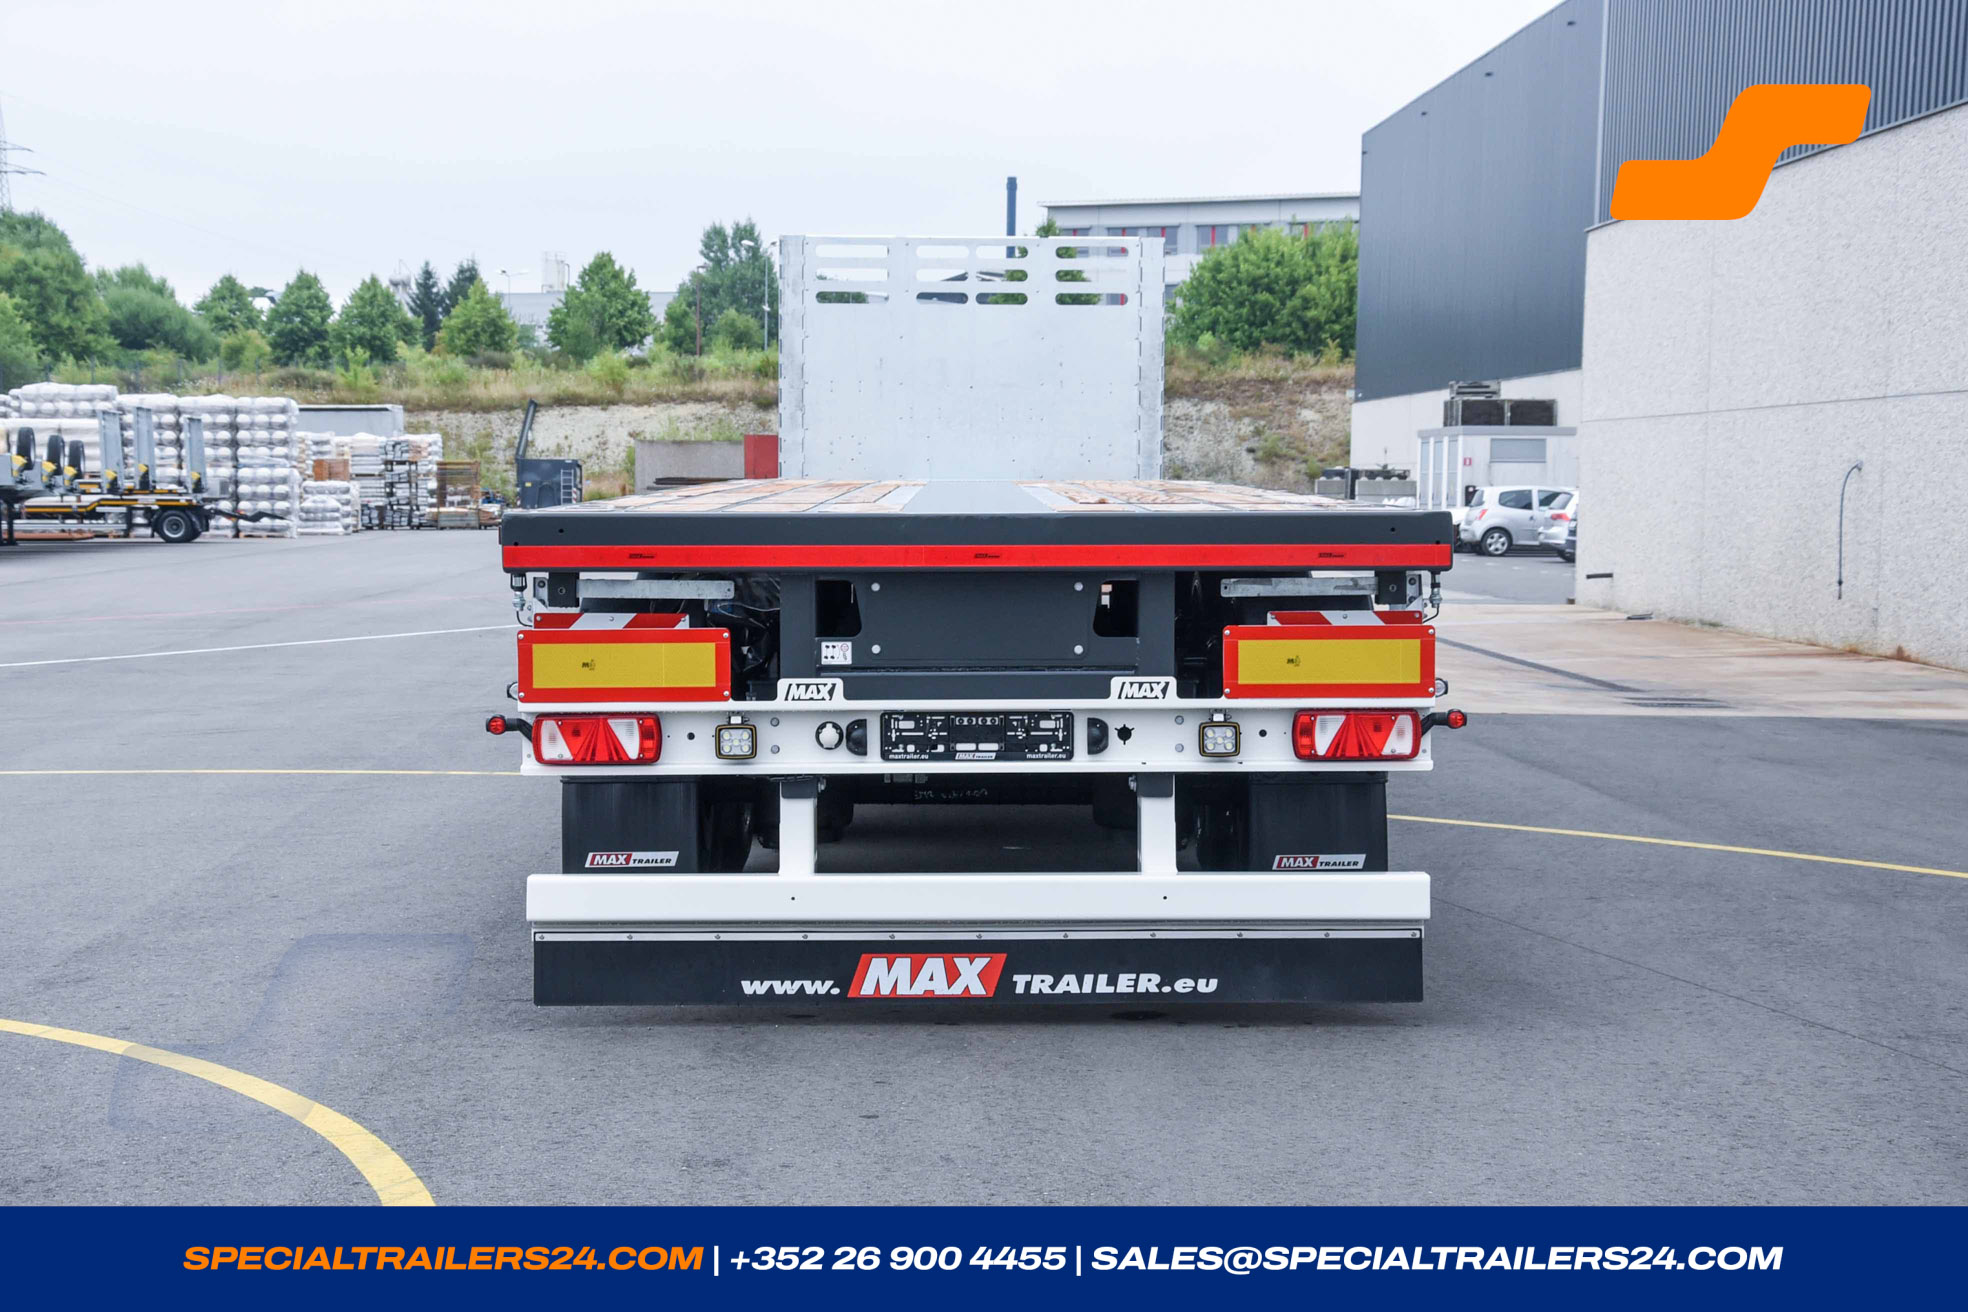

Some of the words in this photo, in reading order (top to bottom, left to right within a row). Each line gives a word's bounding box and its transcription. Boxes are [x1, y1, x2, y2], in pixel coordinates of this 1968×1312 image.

[787, 683, 833, 700] MAX
[1120, 681, 1166, 699] MAX
[1026, 752, 1067, 760] maxtrailer.eu
[593, 854, 628, 865] MAX
[1281, 857, 1315, 868] MAX
[741, 980, 841, 995] www.
[859, 957, 993, 996] MAX
[1012, 973, 1219, 994] TRAILER.eu
